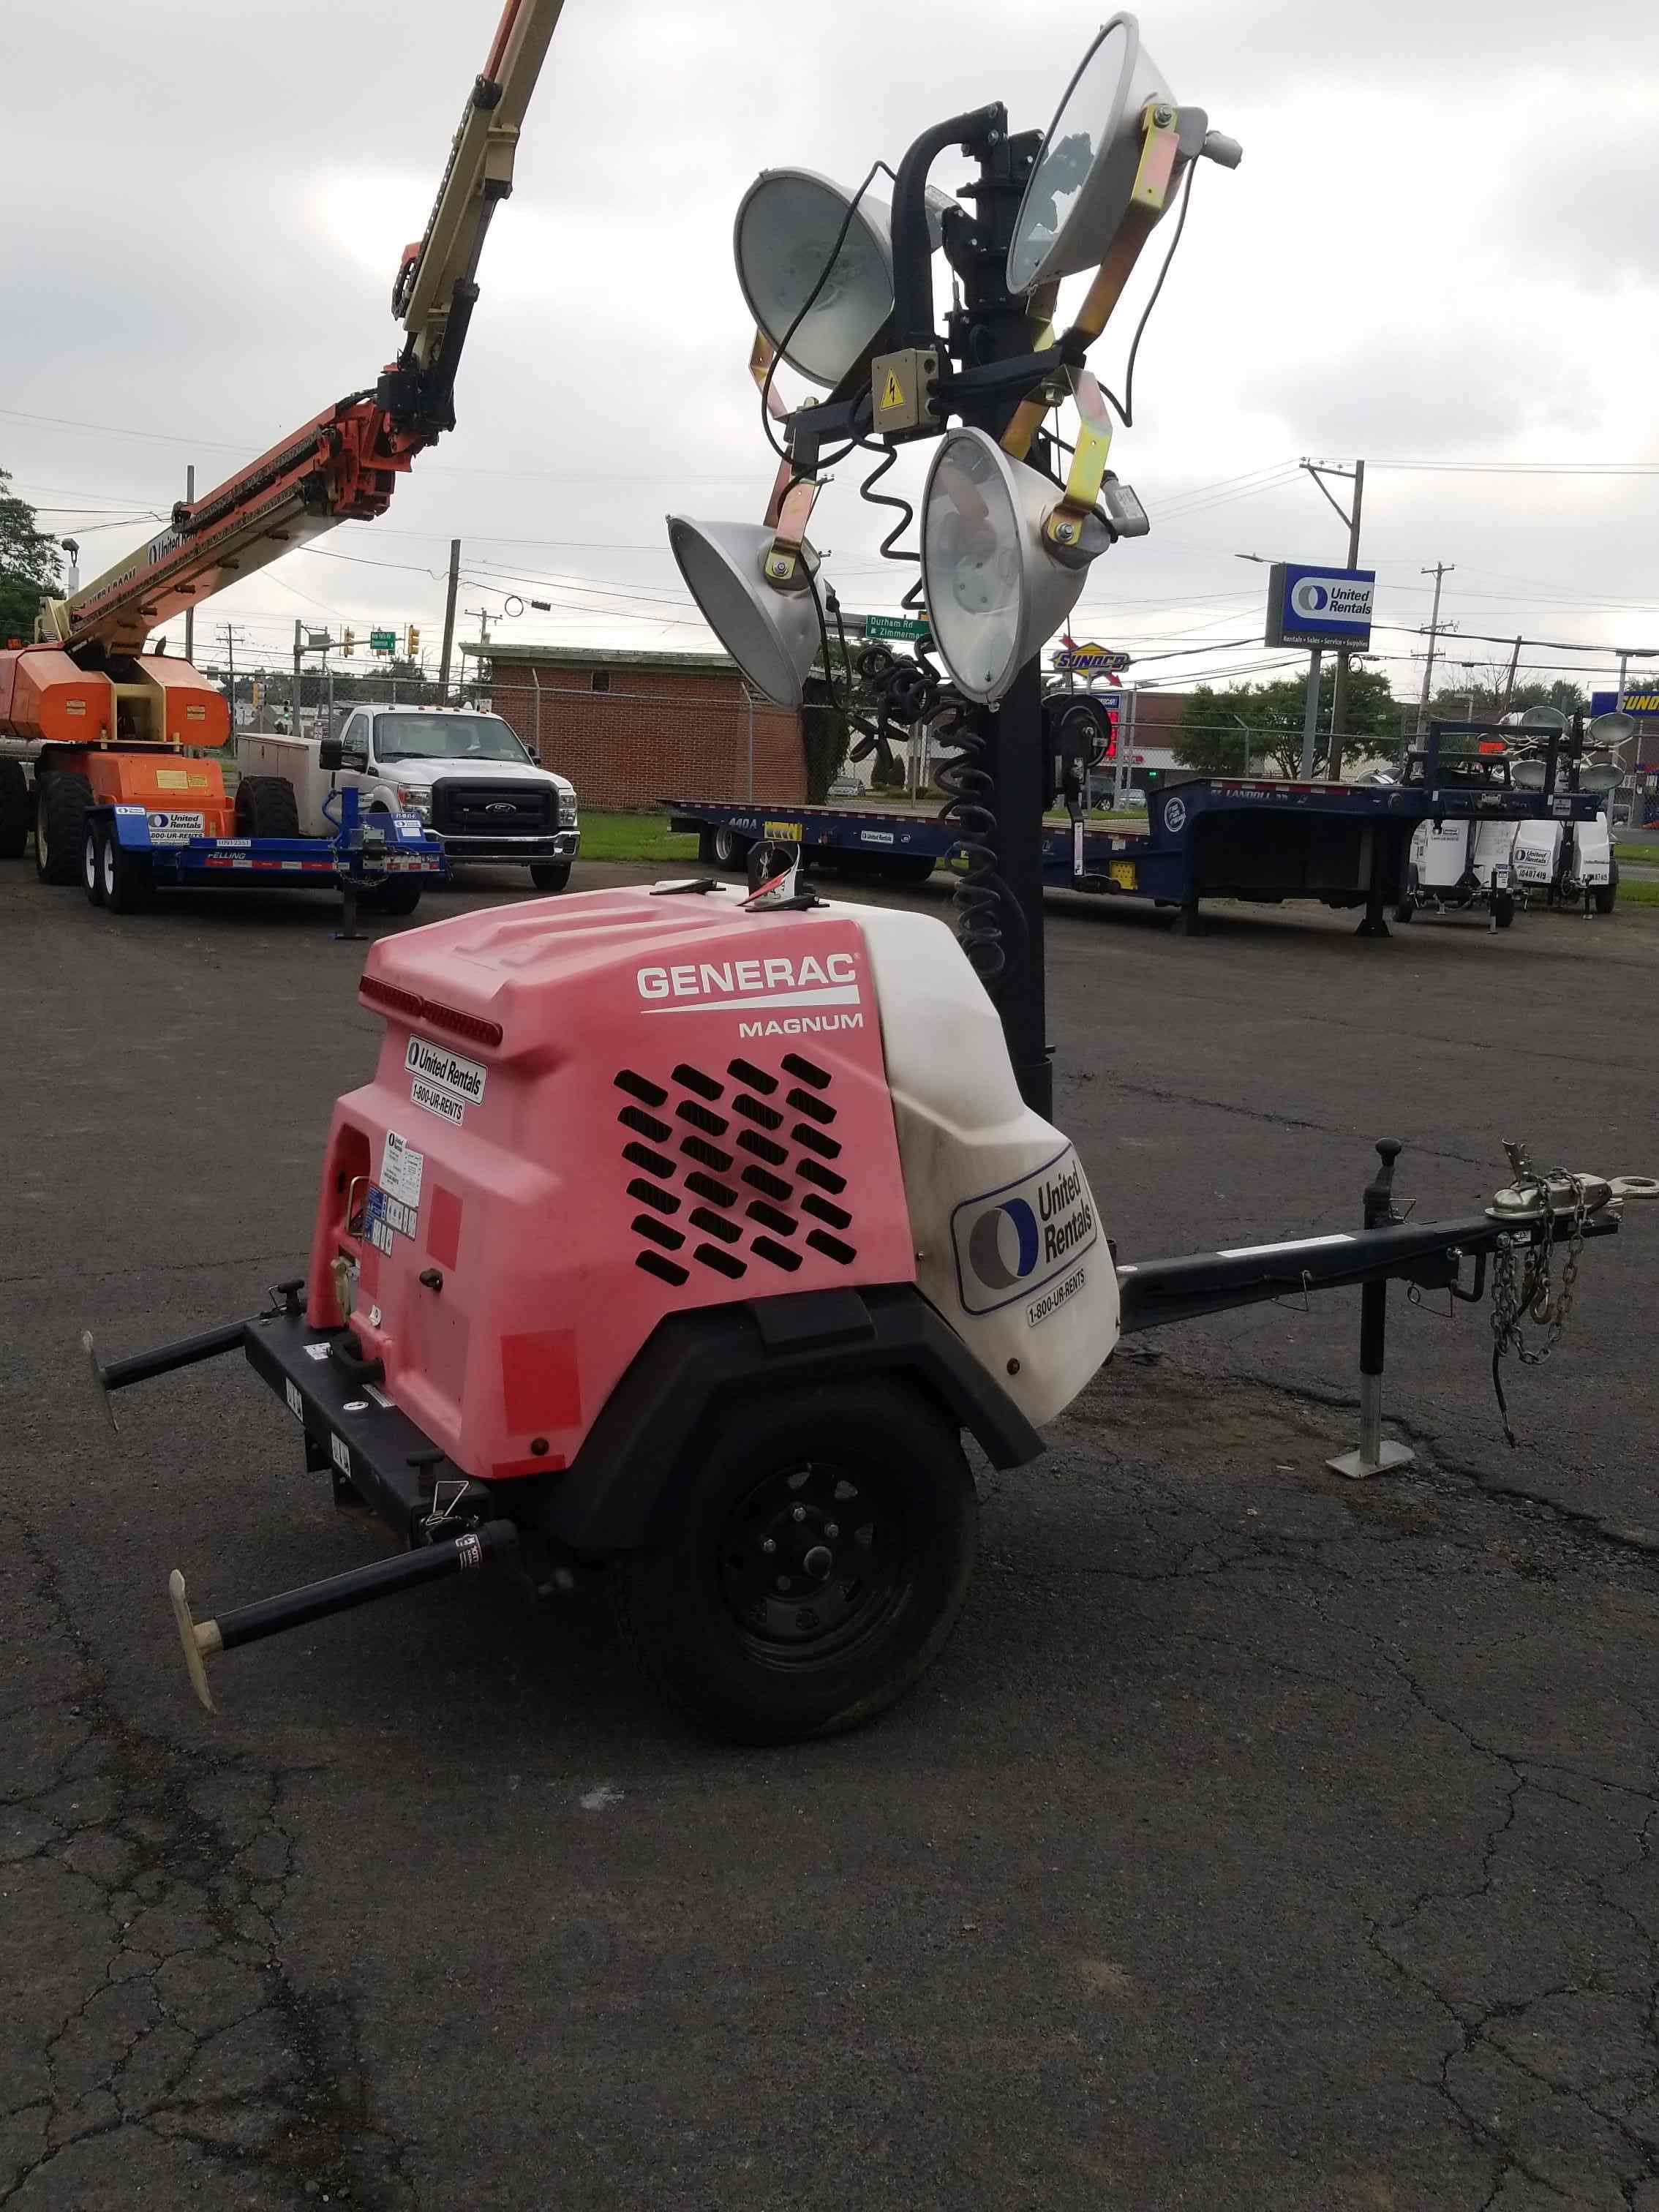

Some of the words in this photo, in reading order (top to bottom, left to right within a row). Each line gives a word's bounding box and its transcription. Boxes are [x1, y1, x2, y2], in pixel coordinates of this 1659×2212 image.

[1331, 587, 1369, 601] United
[1329, 600, 1372, 614] Rentals
[870, 617, 901, 628] Durham
[903, 620, 914, 628] Rd
[1283, 635, 1303, 643] Rentals
[1057, 653, 1127, 669] SUNOCO
[170, 821, 201, 829] Rentals
[1526, 856, 1546, 864] Rentals
[1527, 850, 1547, 858] United
[637, 953, 857, 999] GENERAC
[739, 1012, 864, 1038] MAGNUM
[419, 1047, 449, 1080] United
[446, 1061, 481, 1096] Rentals
[413, 1083, 463, 1120] 1-800-UR-RENTS
[1038, 1159, 1081, 1222] United
[1044, 1199, 1091, 1264] Rentals
[1029, 1268, 1085, 1323] 1-800-UR-RENTS
